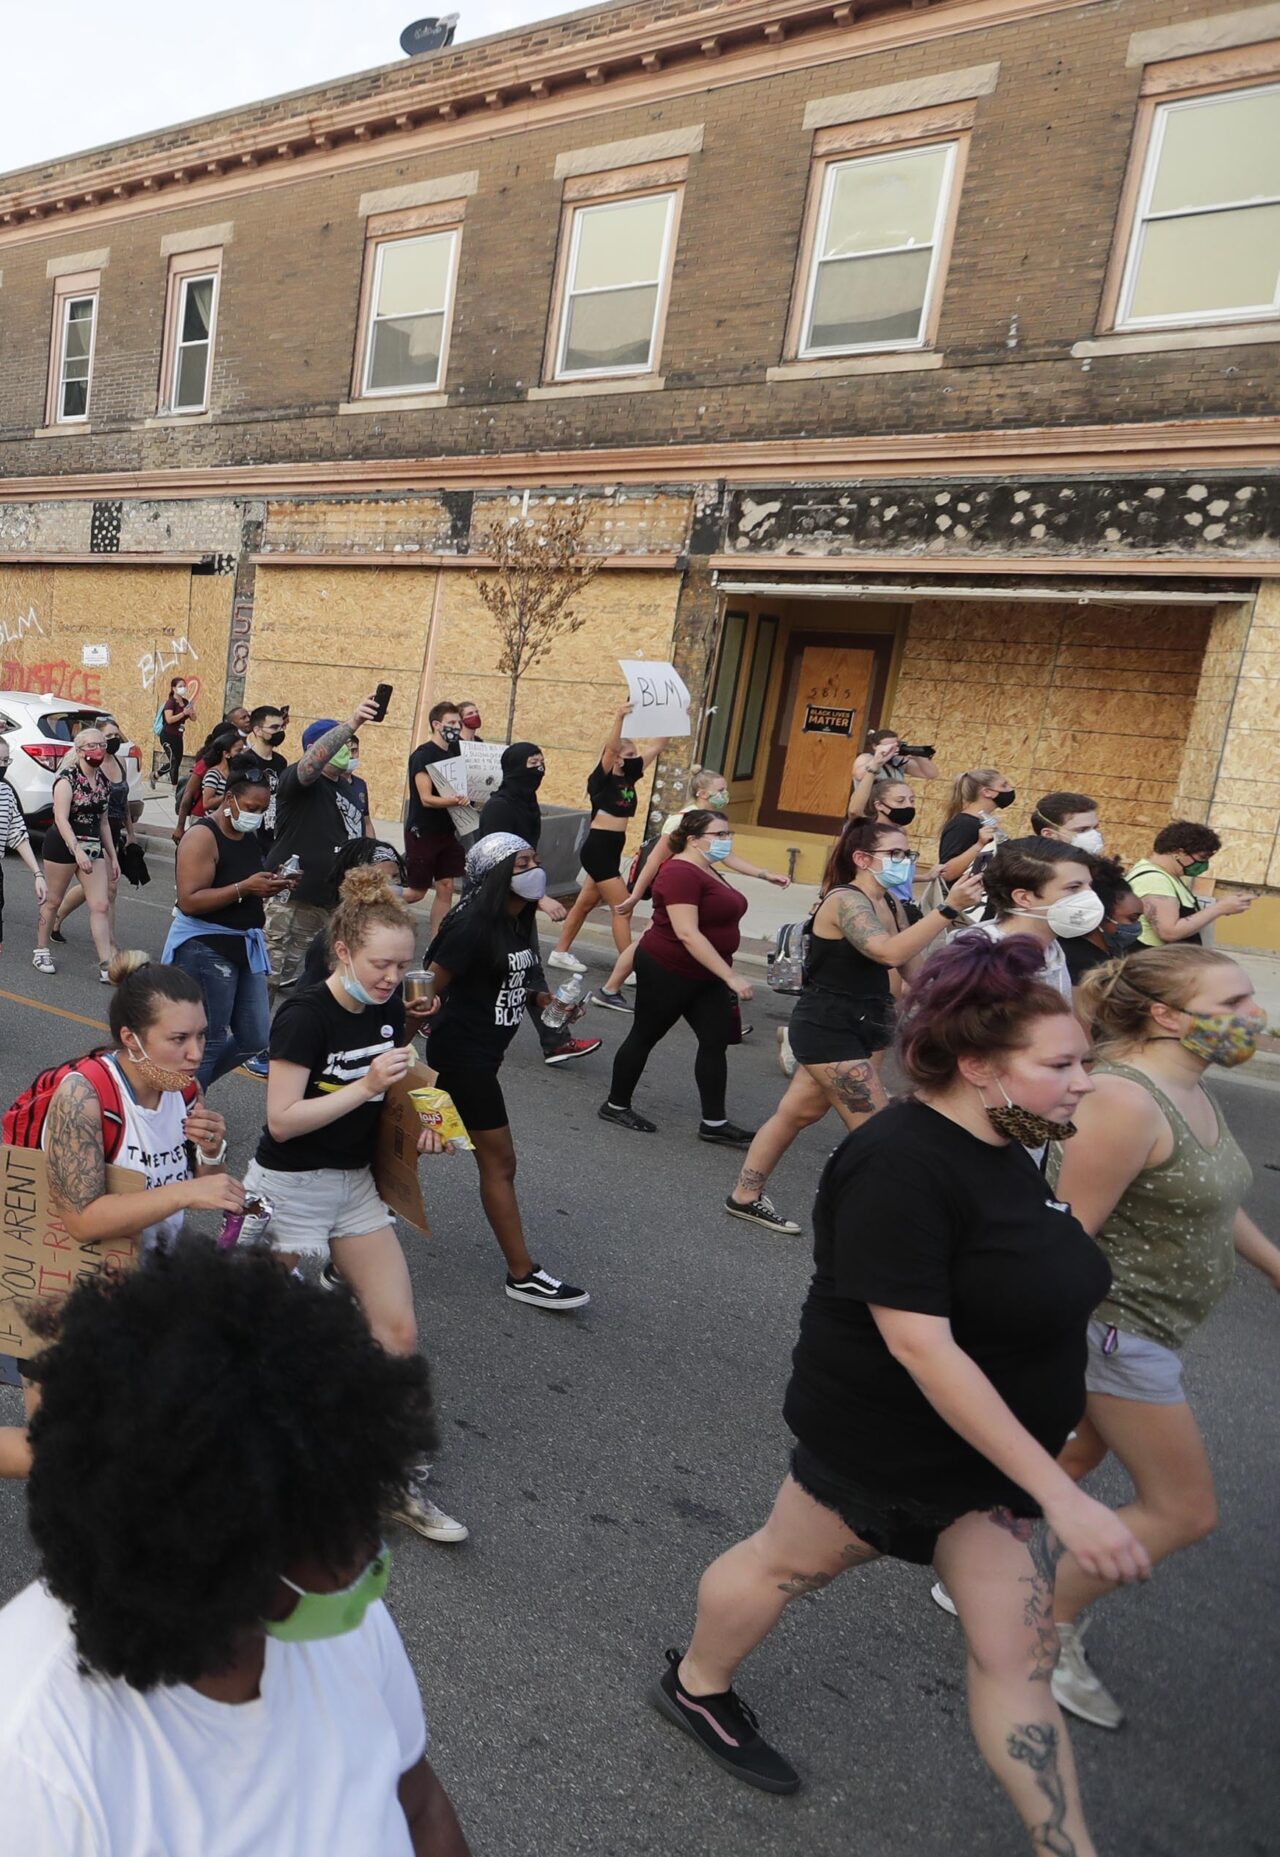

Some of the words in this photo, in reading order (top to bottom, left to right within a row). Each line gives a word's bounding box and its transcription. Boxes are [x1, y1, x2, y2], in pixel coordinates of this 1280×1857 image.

[138, 635, 198, 689] BLM
[637, 677, 682, 708] BLM
[808, 715, 849, 727] MATTER
[3, 1151, 37, 1245] ARENT
[0, 1254, 36, 1302] YOU
